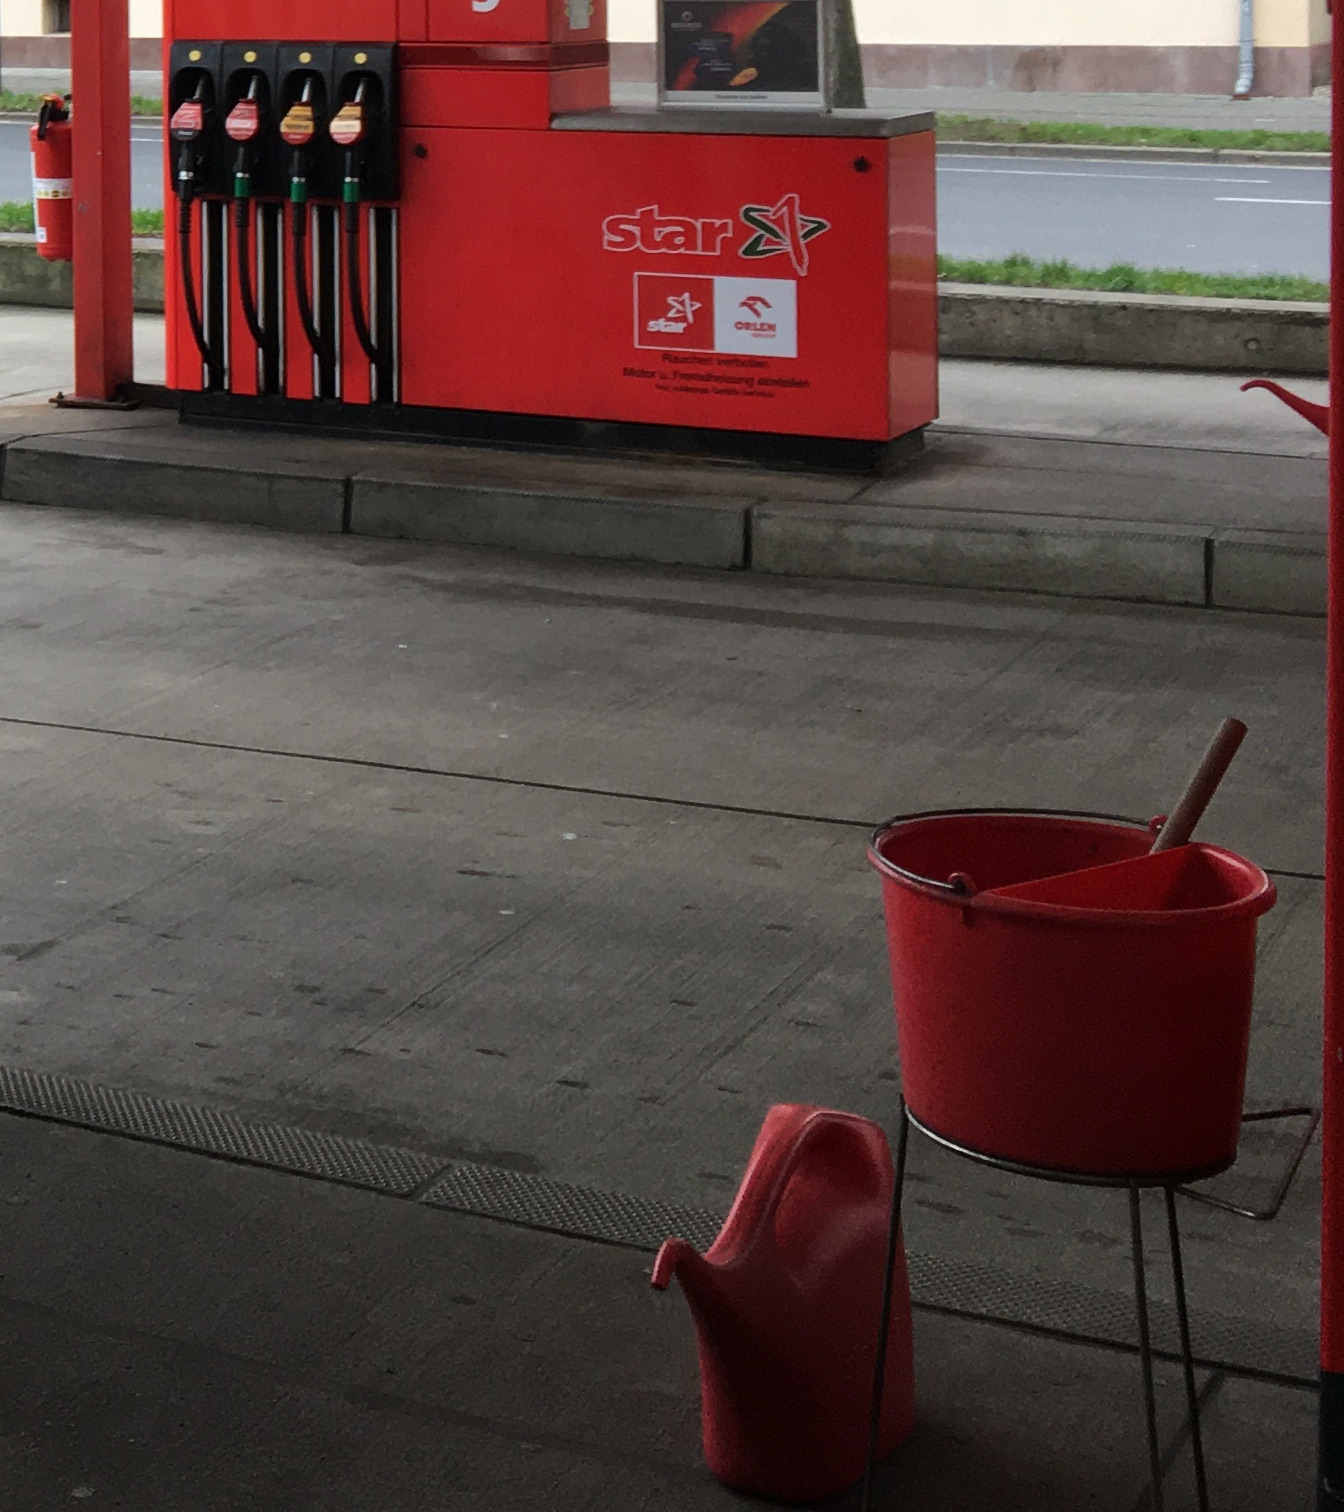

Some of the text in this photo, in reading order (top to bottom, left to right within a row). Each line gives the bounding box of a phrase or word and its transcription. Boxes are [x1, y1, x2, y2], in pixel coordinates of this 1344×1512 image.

[602, 204, 733, 256] star
[646, 318, 688, 333] star
[734, 321, 777, 332] ORLEN
